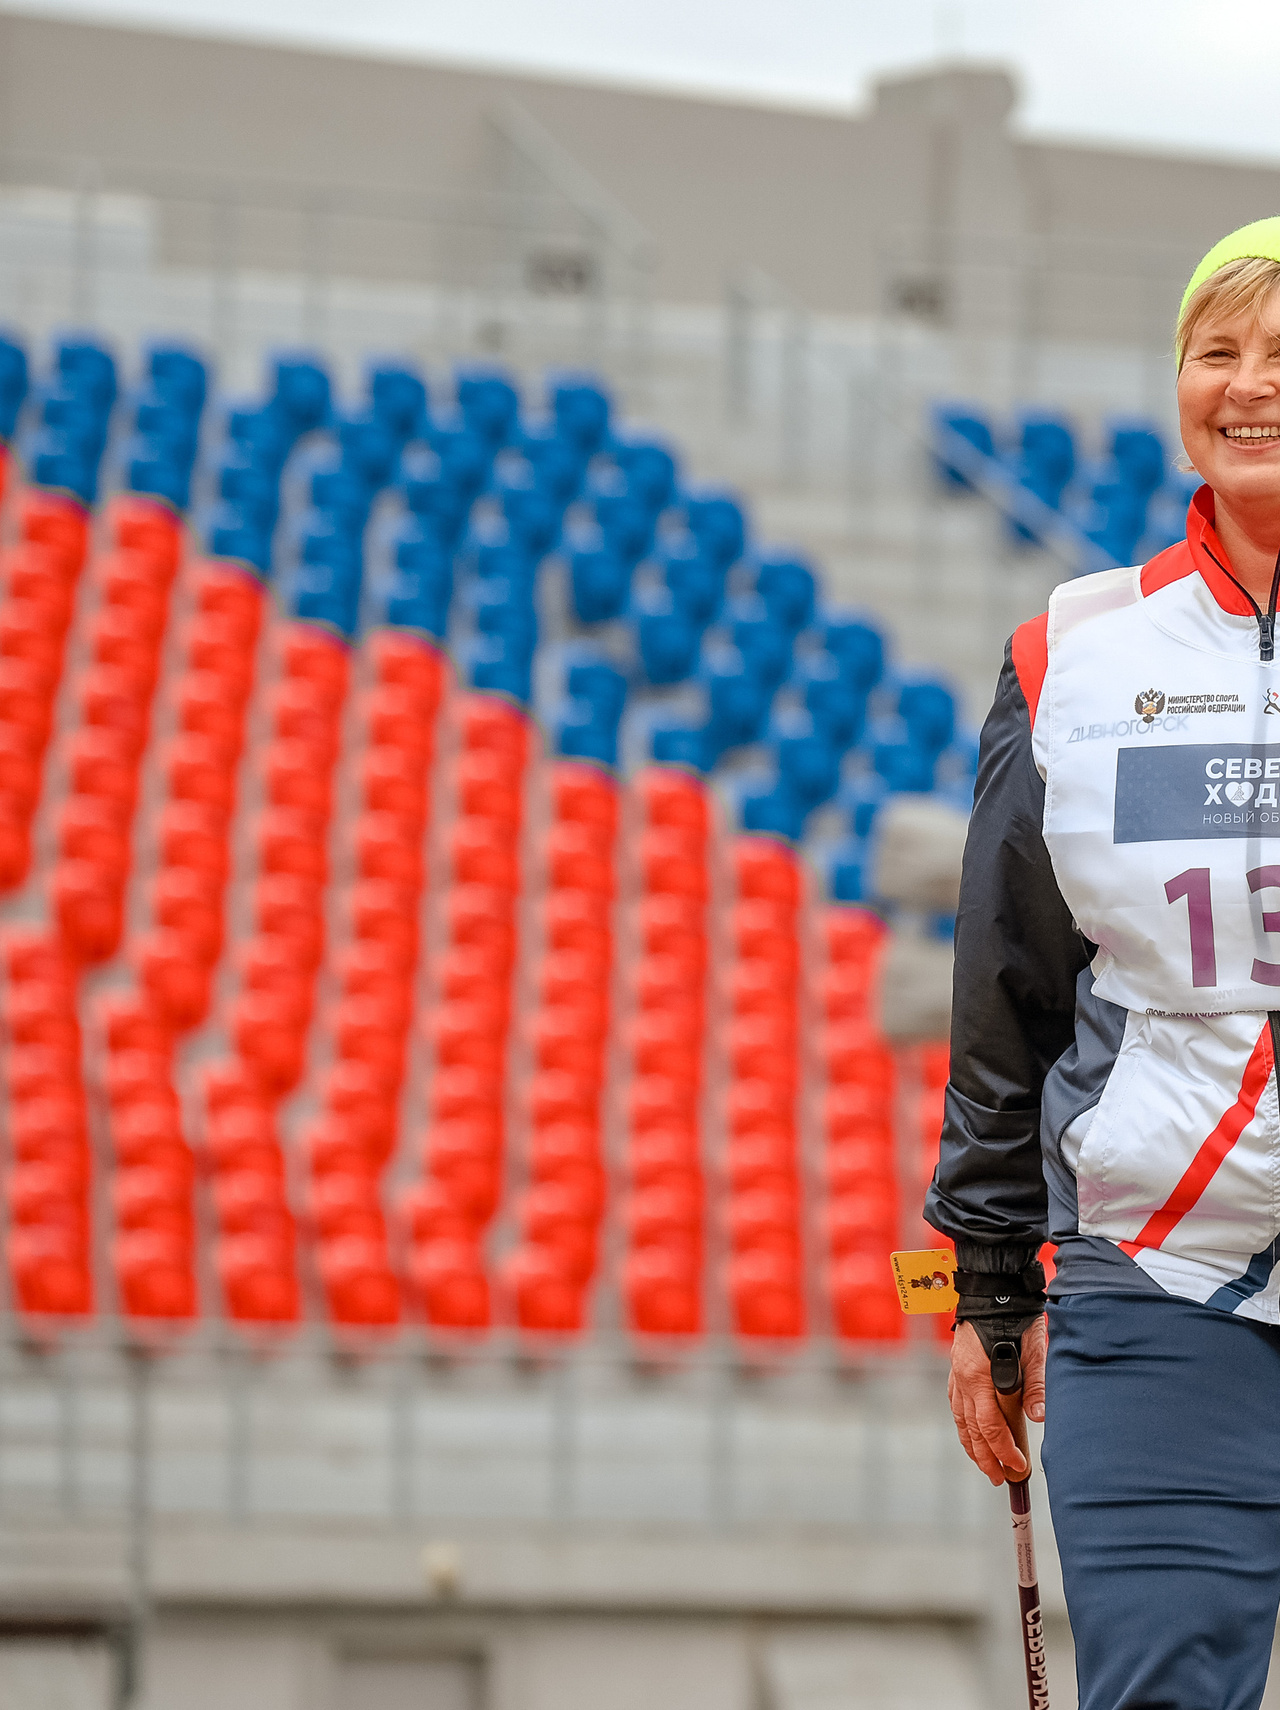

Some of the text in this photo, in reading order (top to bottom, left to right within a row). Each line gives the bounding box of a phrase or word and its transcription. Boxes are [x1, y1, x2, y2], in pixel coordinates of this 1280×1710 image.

[1167, 694, 1239, 705] МИНИСТЕРСТВО СПОРТА
[1166, 703, 1246, 715] РОССИЙСКОЙ ФЕДЕРАЦИИ
[1067, 715, 1190, 743] ДИВНОГОРСК
[1203, 810, 1255, 824] НОВЫЙ
[1026, 1604, 1050, 1710] СЕВЕРНА
